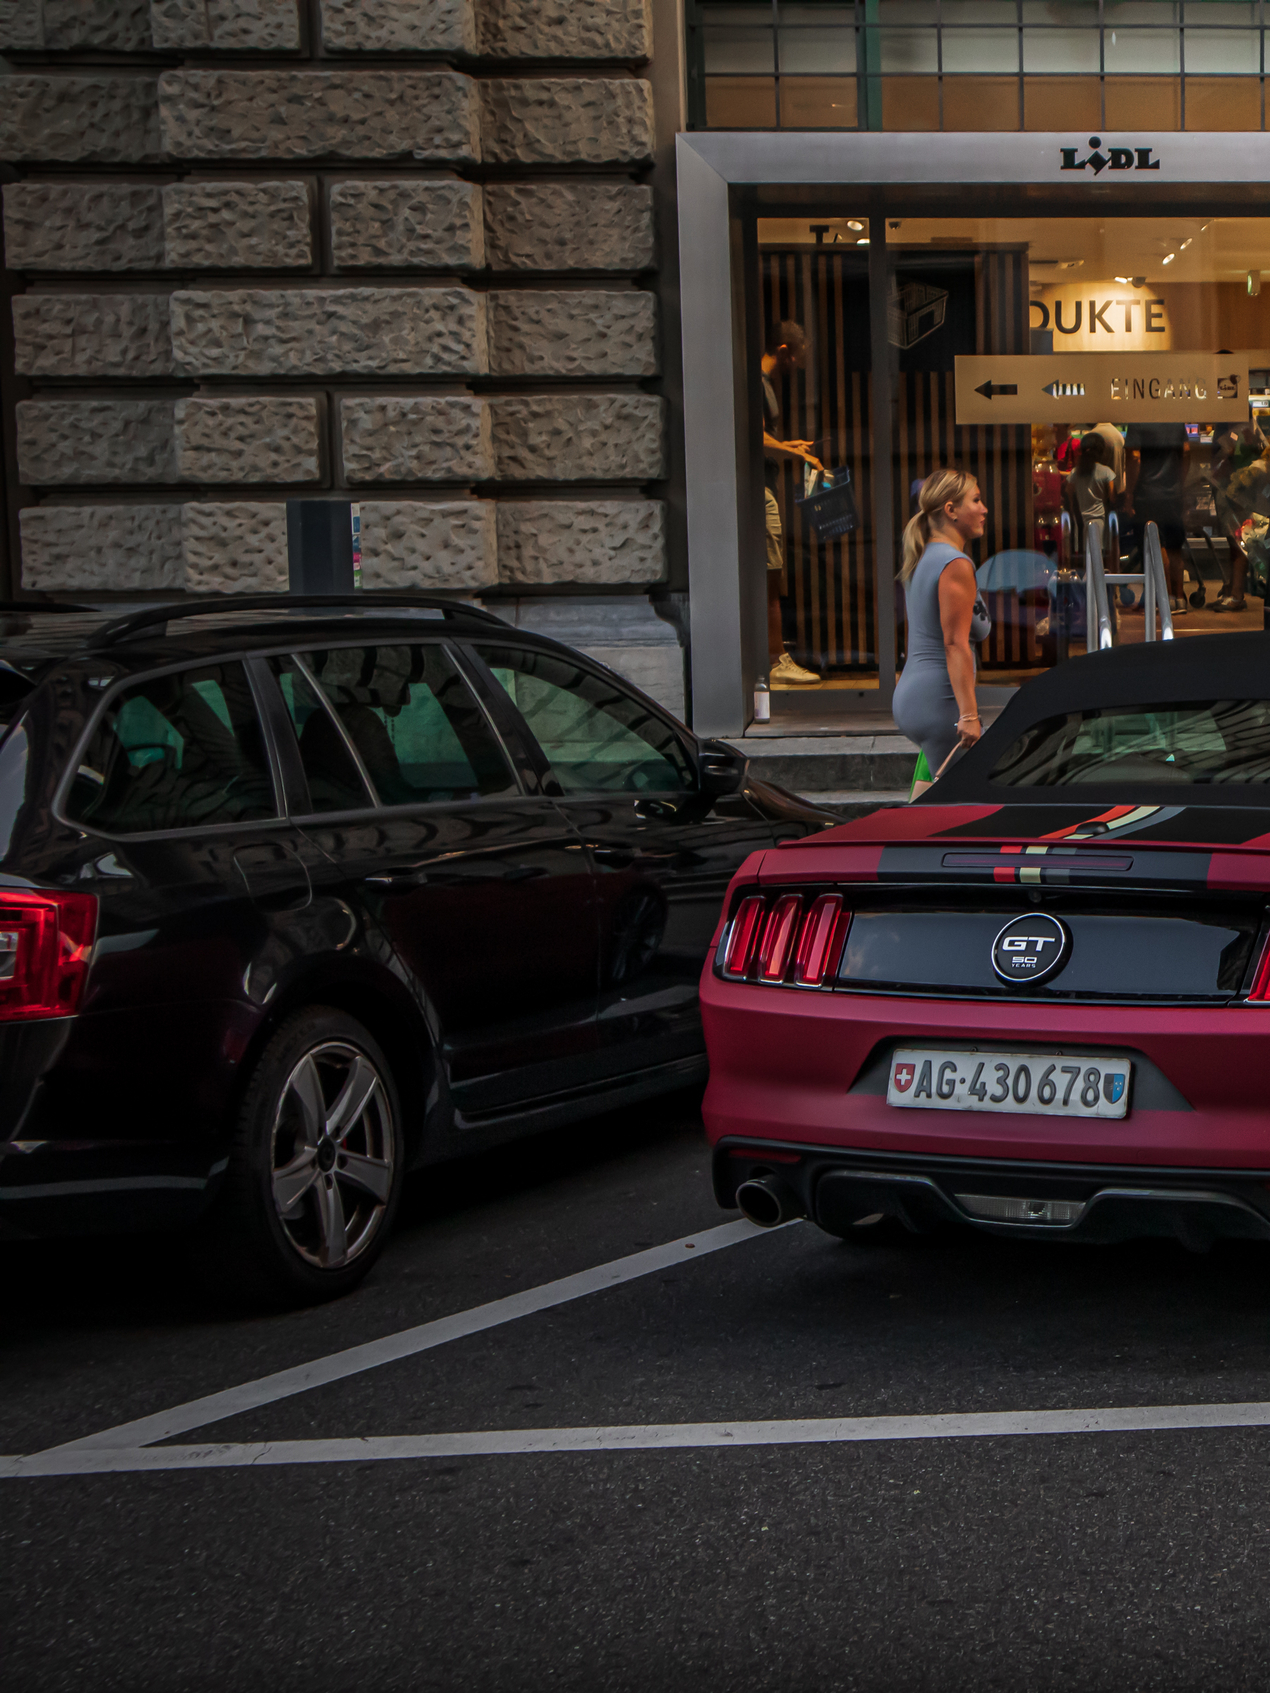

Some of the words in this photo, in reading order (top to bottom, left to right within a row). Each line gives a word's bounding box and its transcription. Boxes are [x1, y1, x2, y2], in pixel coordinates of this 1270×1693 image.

[1110, 378, 1207, 400] EINGANG
[1002, 936, 1056, 952] GT
[1011, 956, 1038, 964] 50
